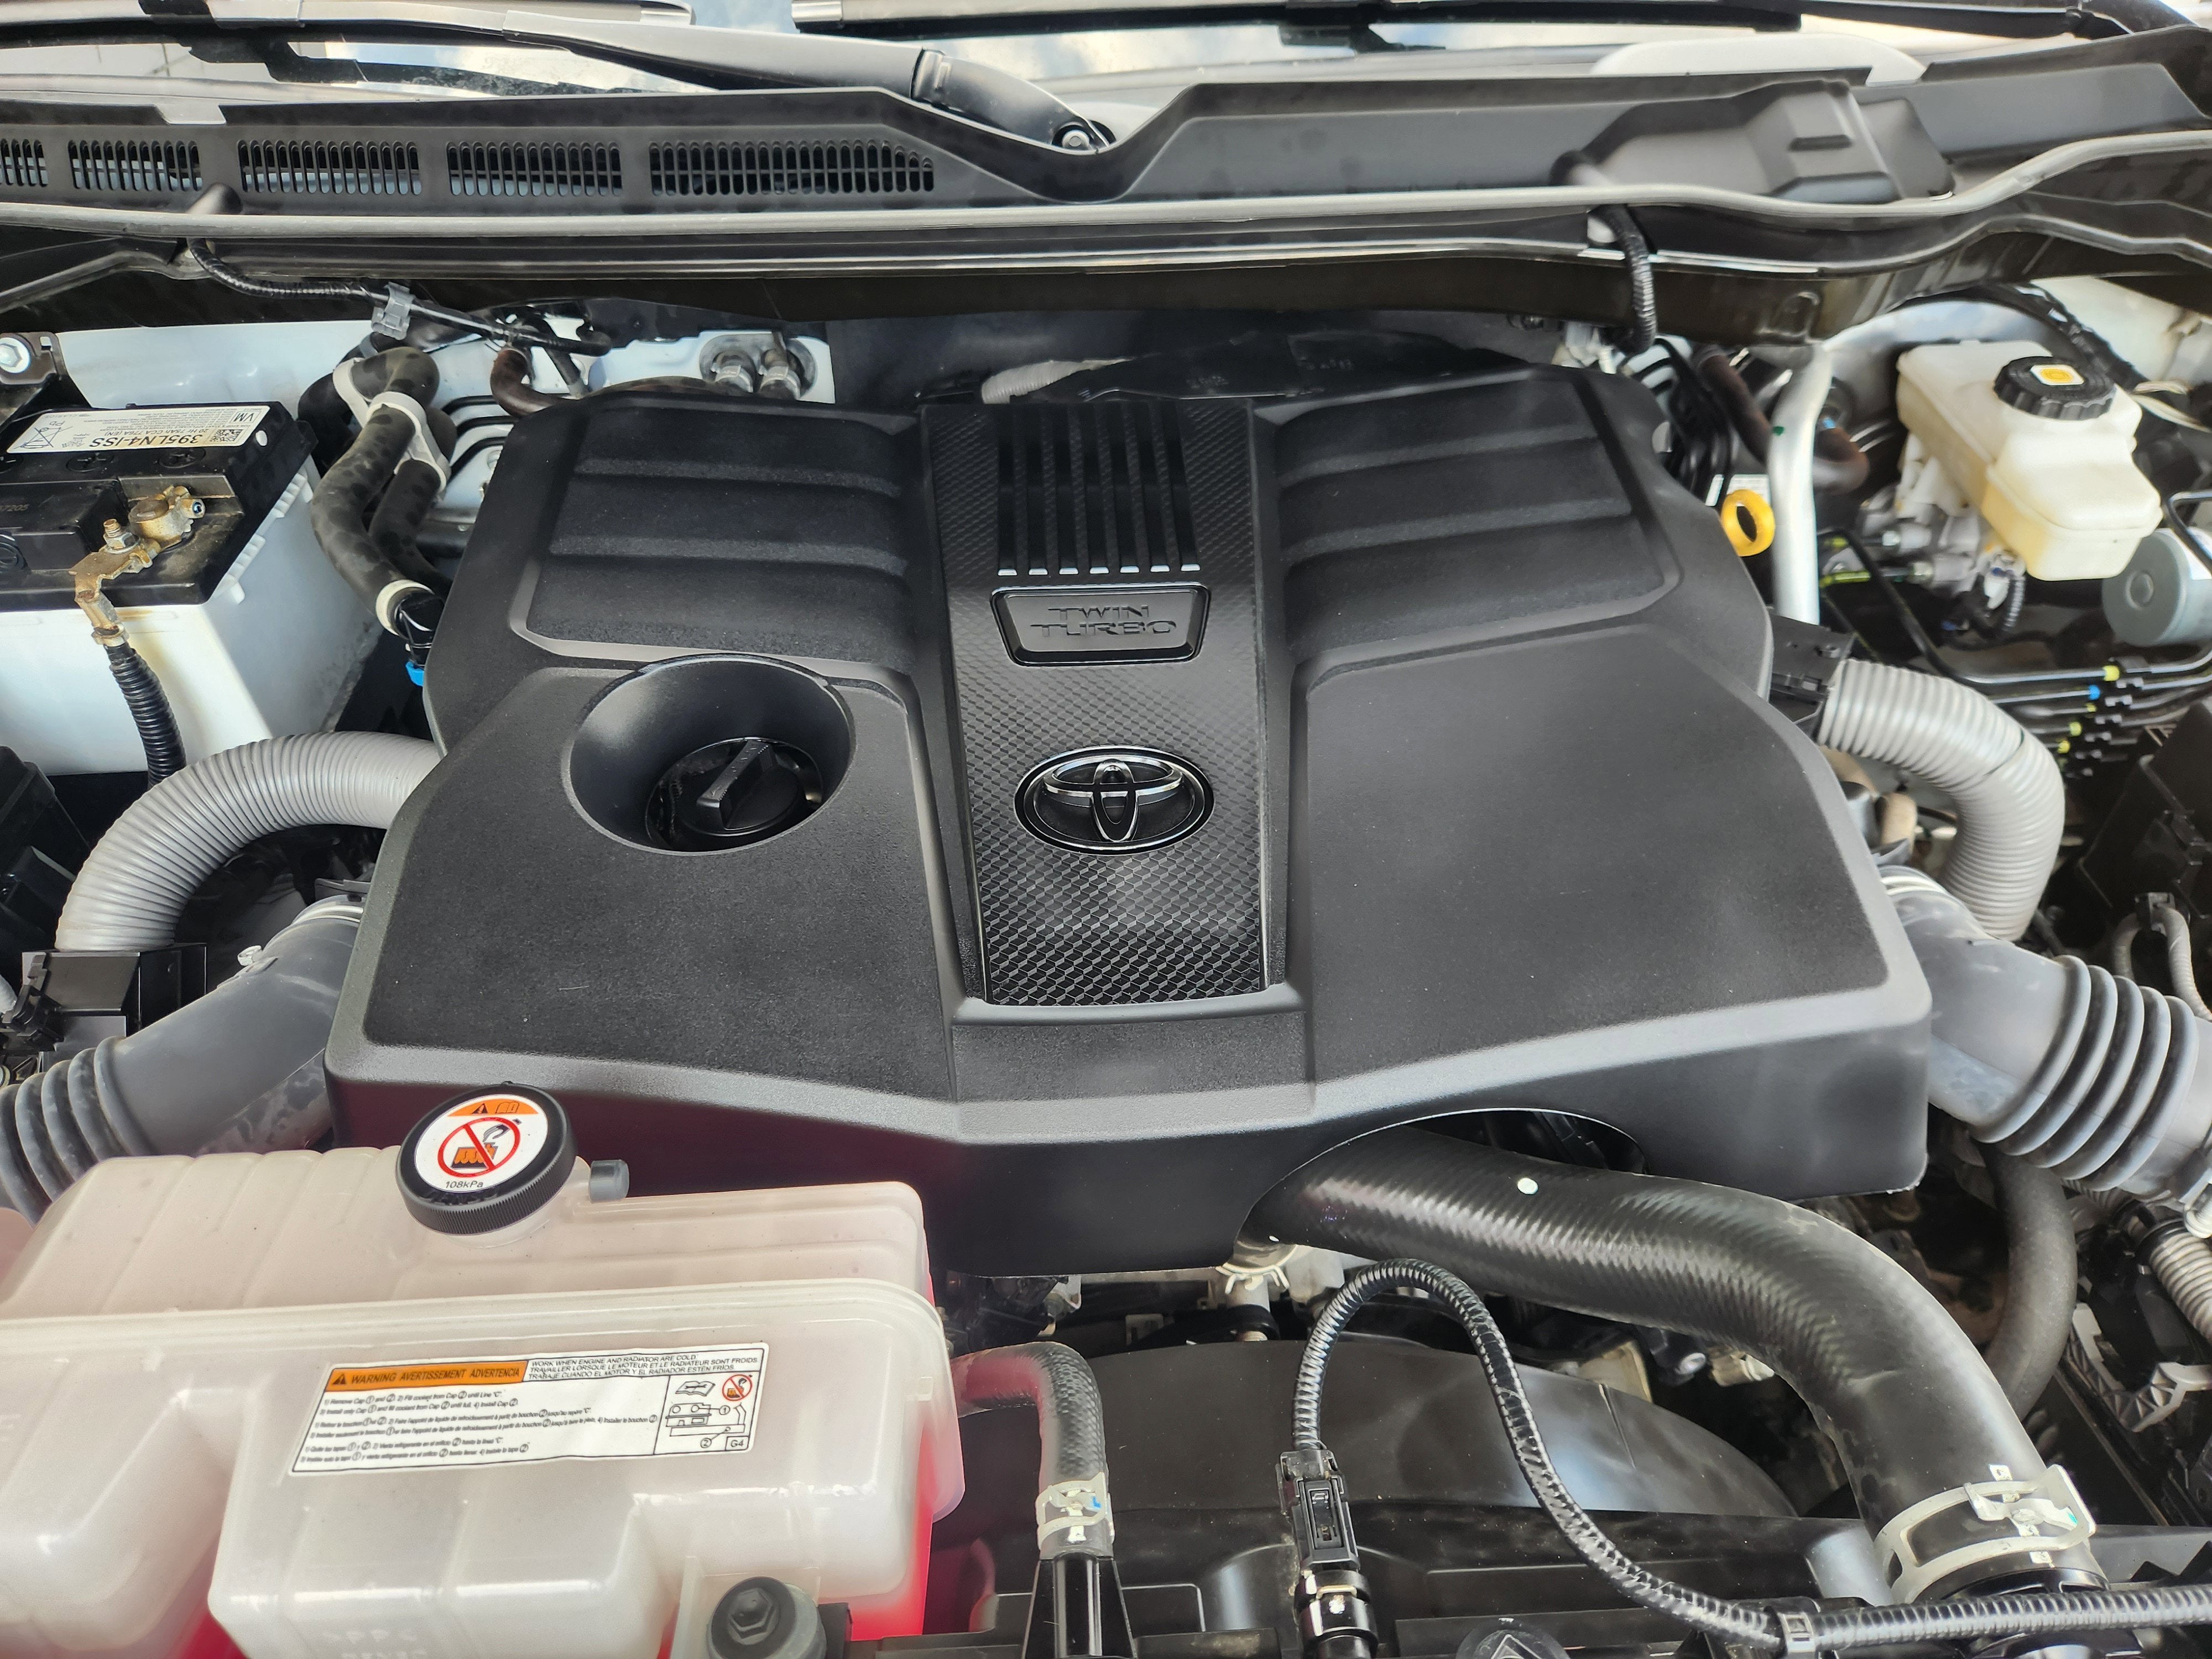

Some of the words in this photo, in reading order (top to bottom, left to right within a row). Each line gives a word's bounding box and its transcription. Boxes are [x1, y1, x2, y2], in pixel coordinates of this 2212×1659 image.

[233, 413, 254, 422] VM
[89, 434, 203, 447] 395LN4-ISS
[1048, 605, 1149, 620] TWIN
[1030, 620, 1177, 637] TURBO
[445, 1180, 484, 1188] 108kPa
[351, 1373, 395, 1384] WARNING
[401, 1369, 466, 1380] AVERTISSEMENT
[470, 1368, 519, 1378] ADVERTENCIA
